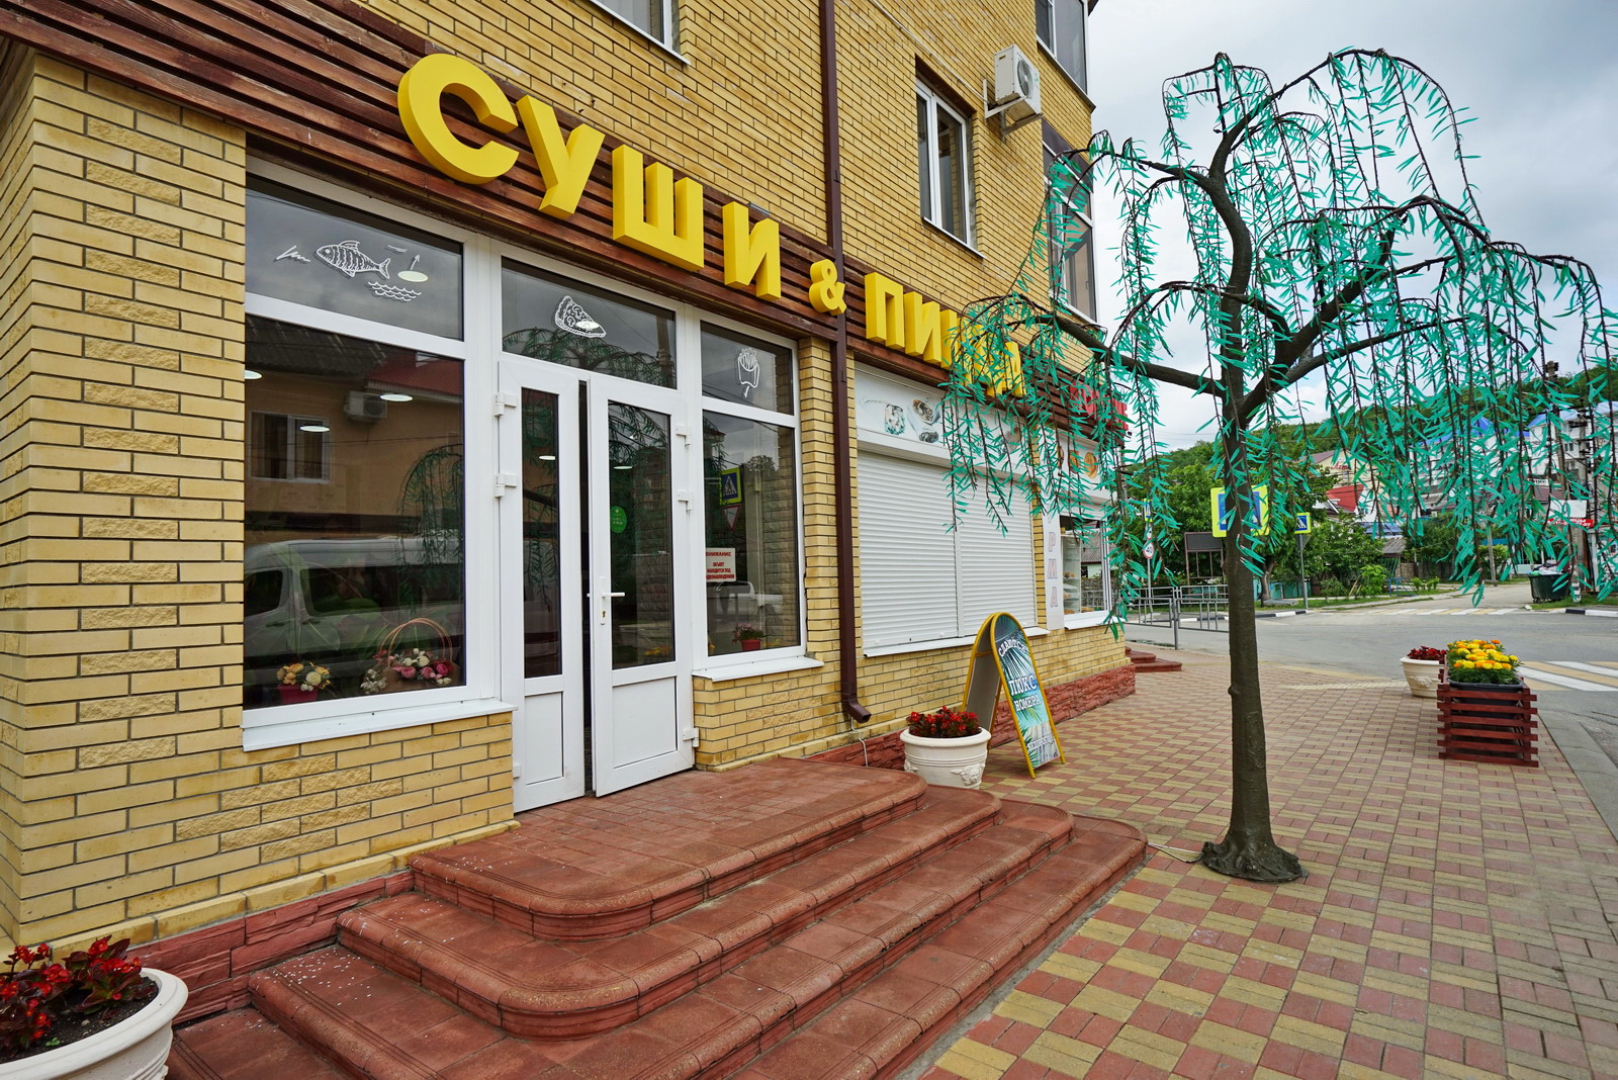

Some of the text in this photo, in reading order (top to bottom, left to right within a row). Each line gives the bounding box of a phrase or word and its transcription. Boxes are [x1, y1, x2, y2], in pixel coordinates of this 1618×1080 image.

[397, 53, 782, 299] СУШИ
[809, 259, 846, 316] &
[1009, 674, 1037, 696] ЛЮКС
